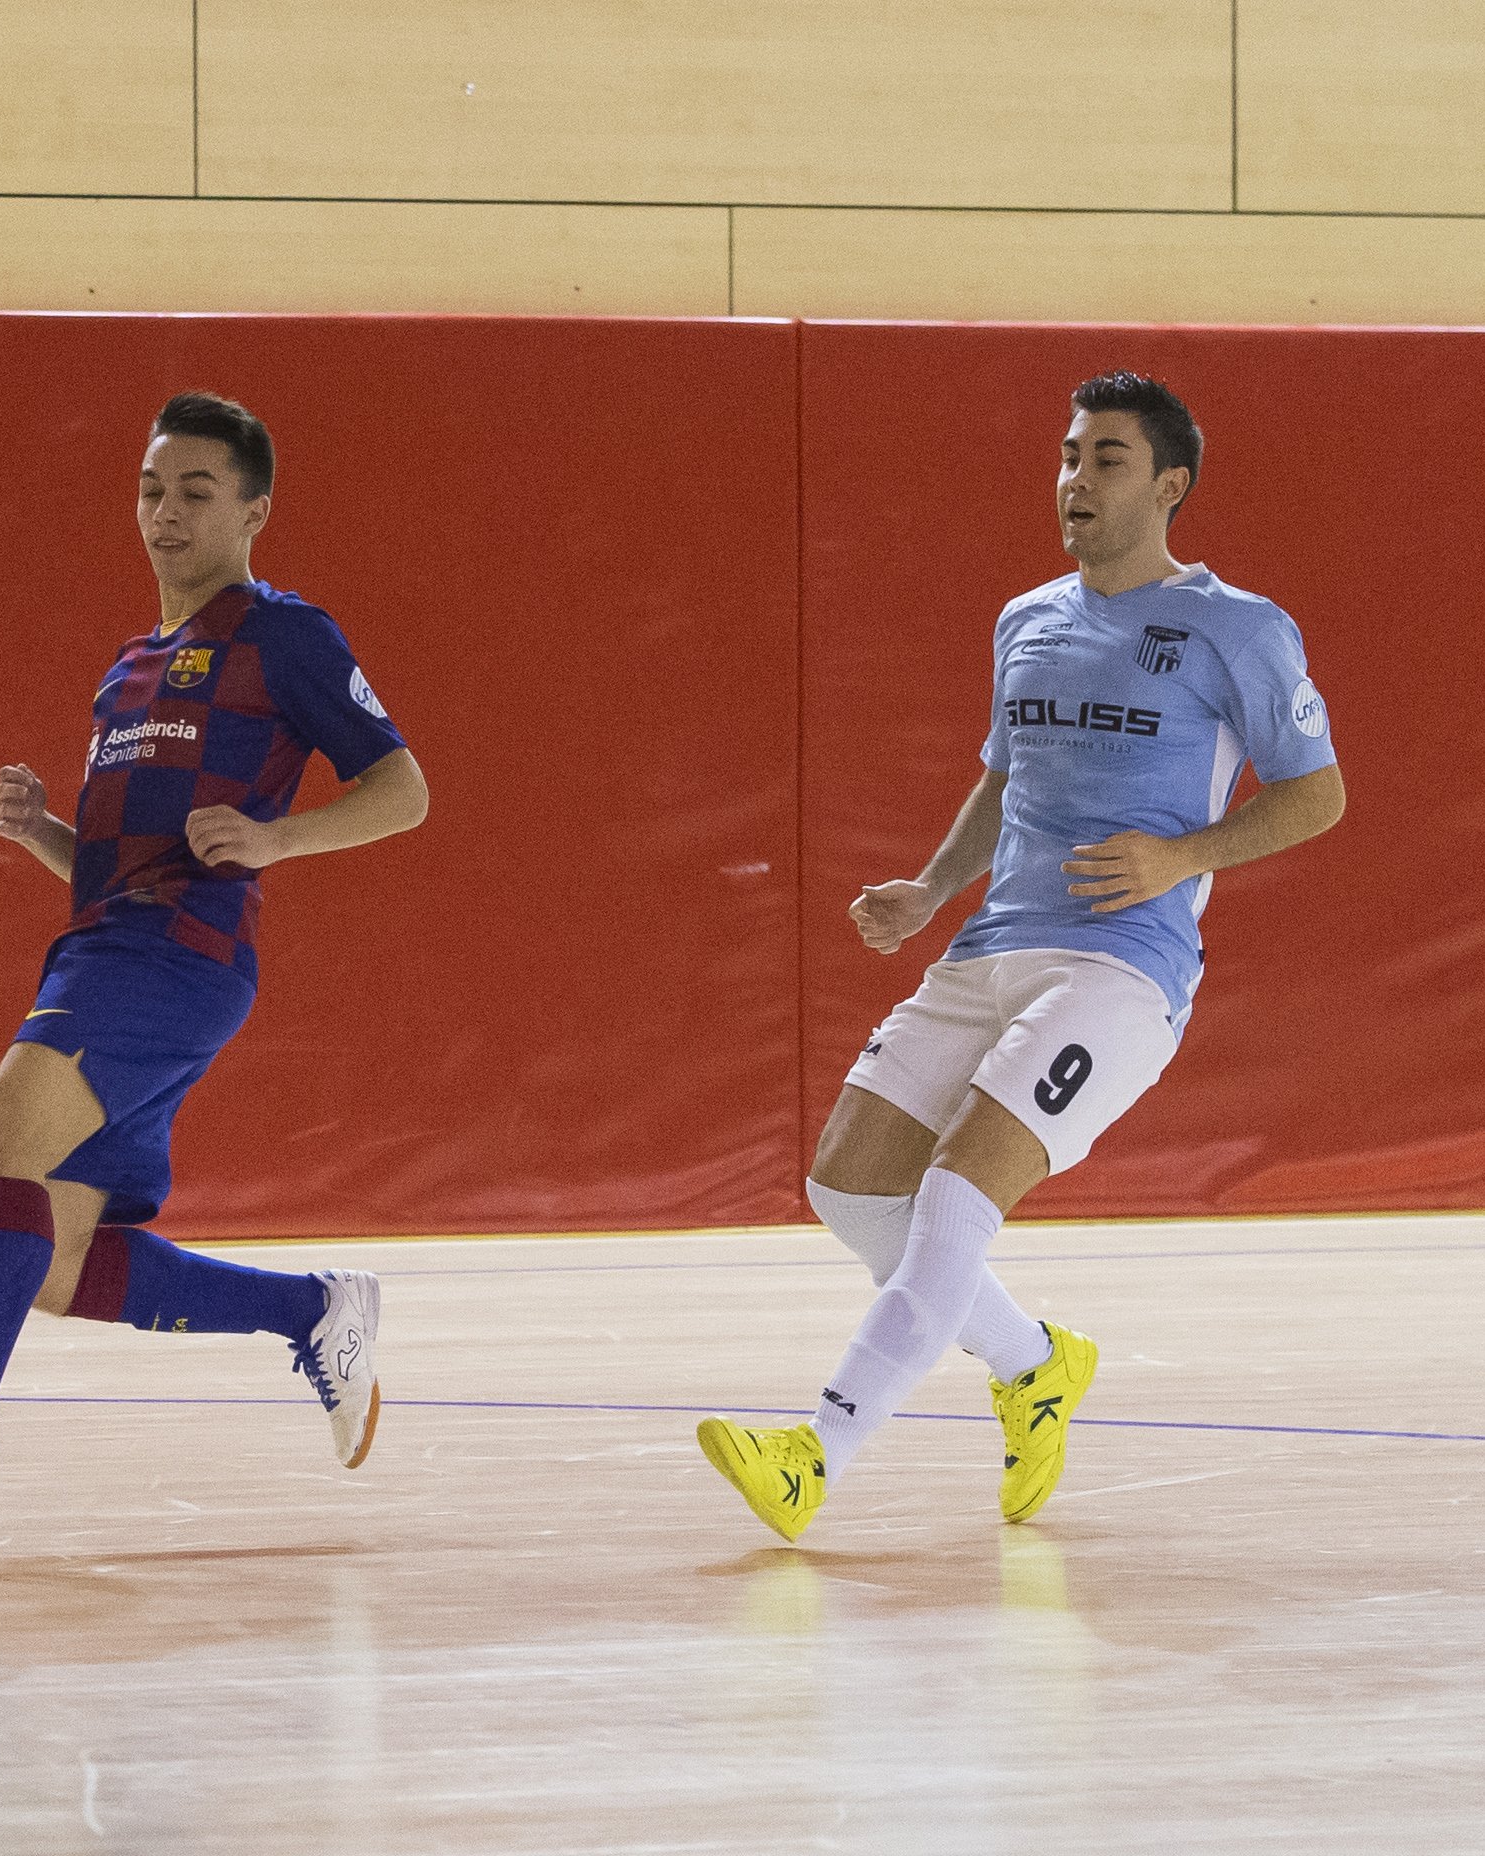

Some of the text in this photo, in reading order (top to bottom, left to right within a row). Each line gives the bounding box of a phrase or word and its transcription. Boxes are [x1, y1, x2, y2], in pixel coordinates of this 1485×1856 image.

[104, 718, 197, 746] Assistència
[98, 739, 156, 767] Sanitària
[1033, 1042, 1093, 1116] 9
